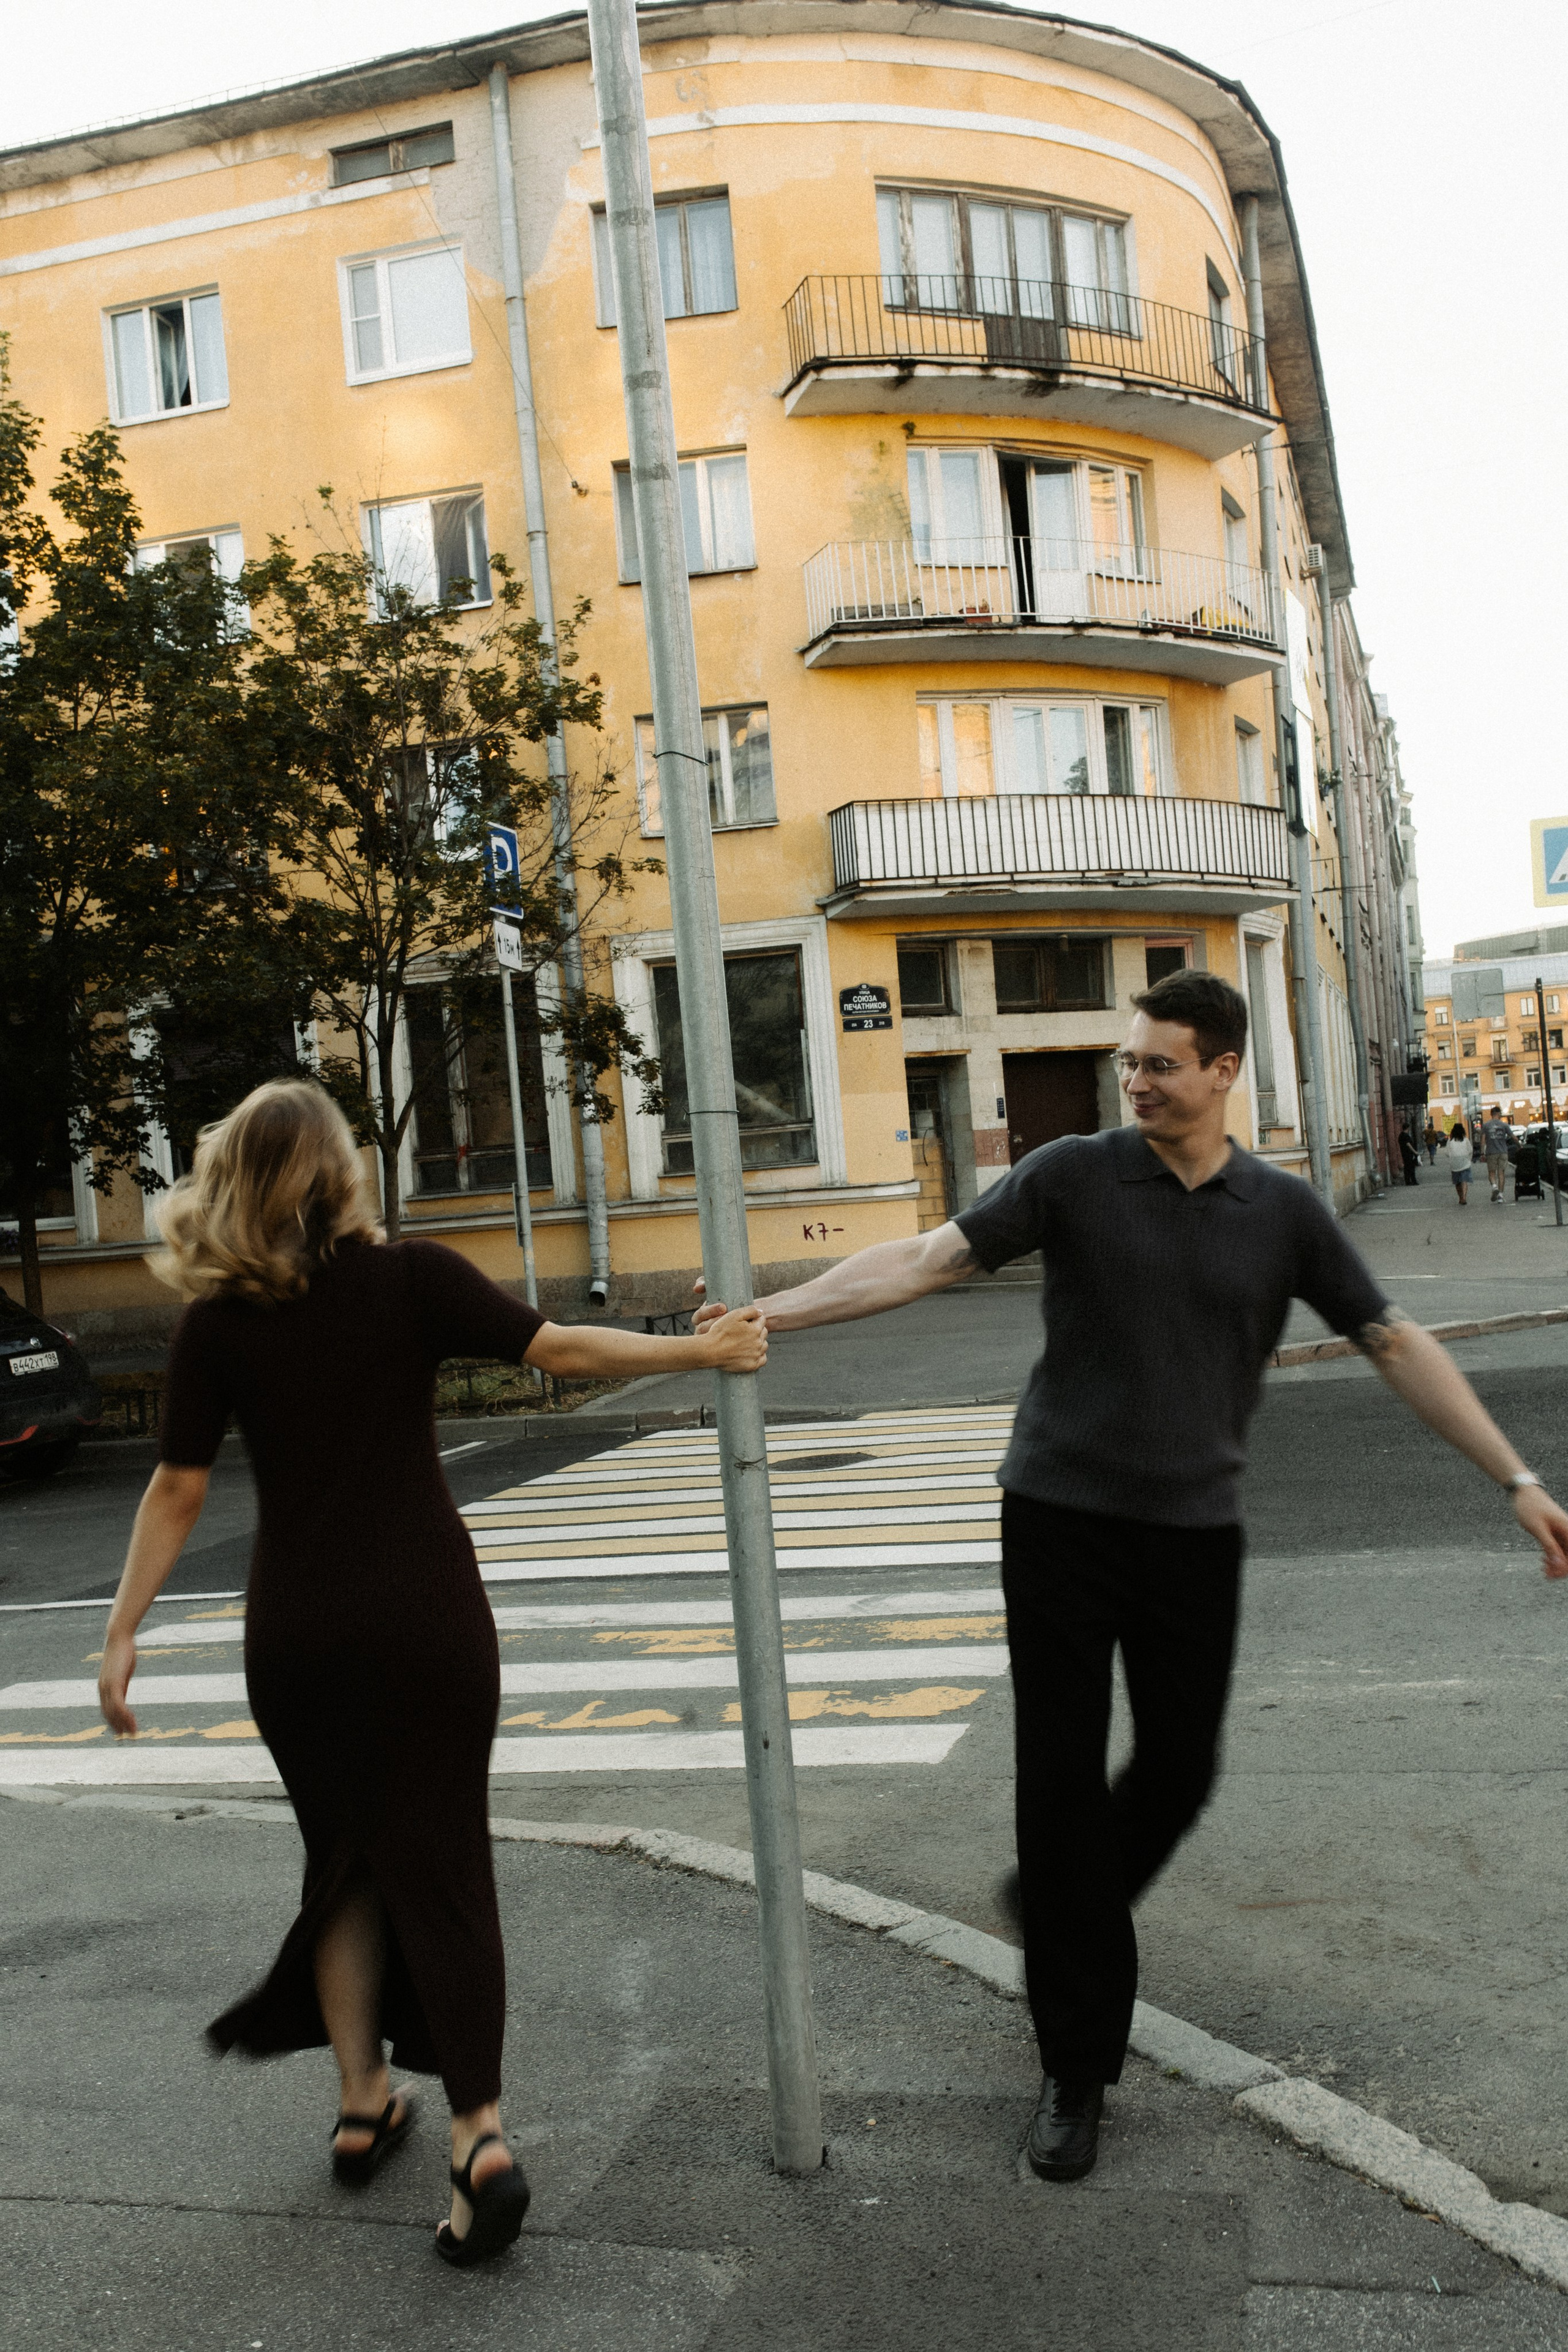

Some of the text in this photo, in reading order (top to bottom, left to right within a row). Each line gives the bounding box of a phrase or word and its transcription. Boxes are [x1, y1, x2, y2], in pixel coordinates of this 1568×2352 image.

[491, 834, 513, 895] P
[843, 1001, 887, 1011] ПЕЧАТНИКОВ
[864, 1020, 873, 1028] 23
